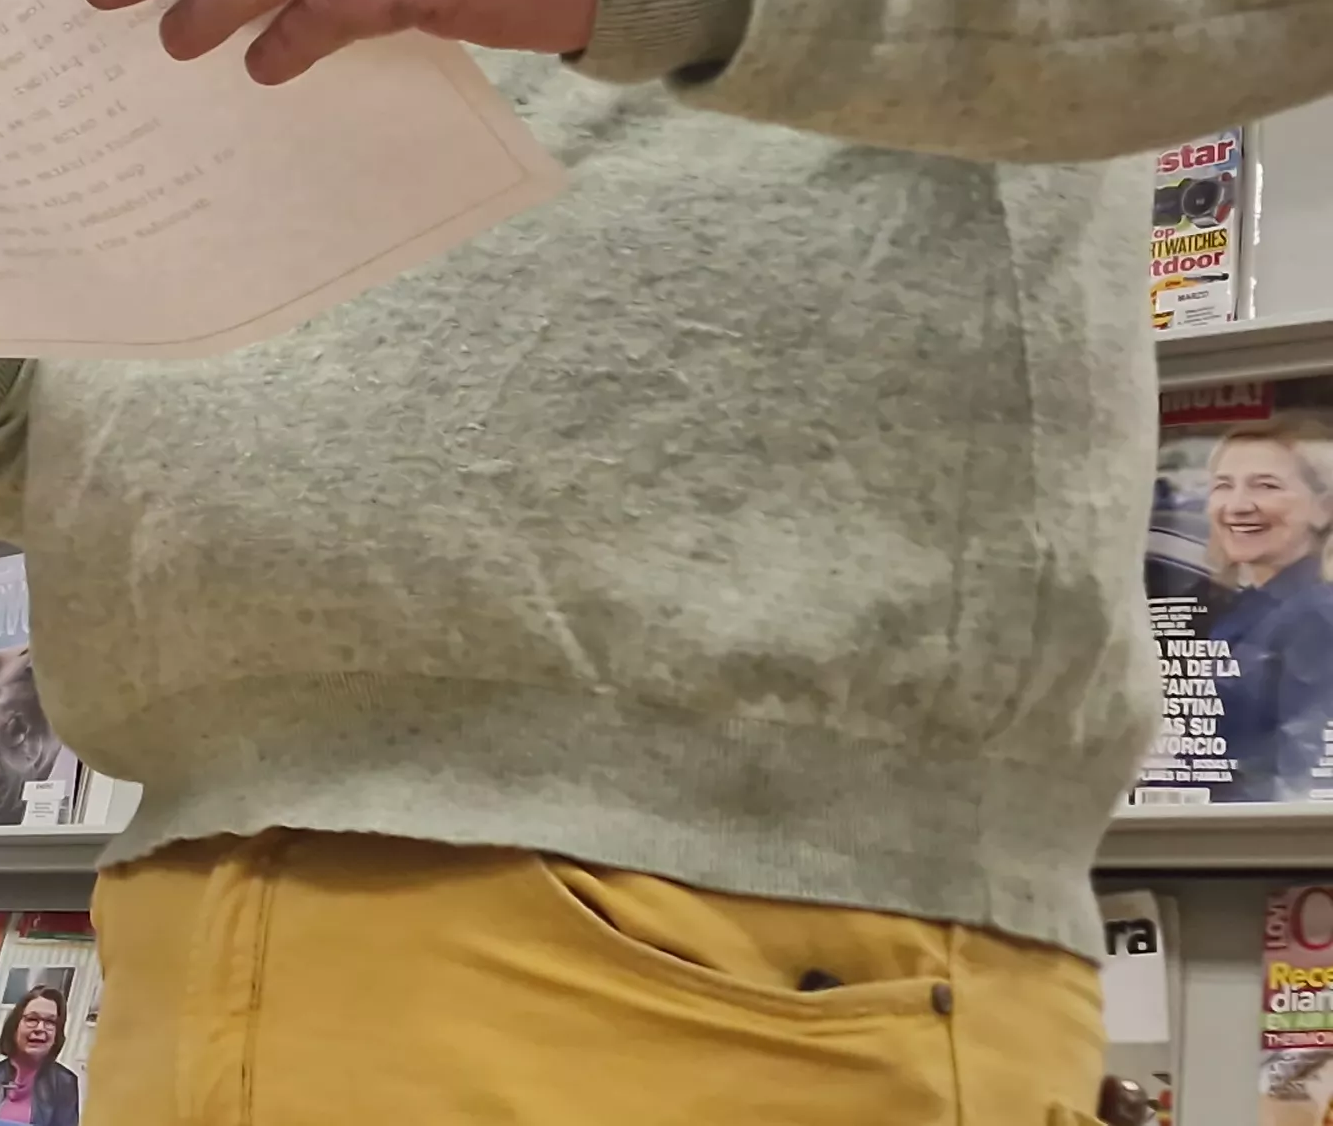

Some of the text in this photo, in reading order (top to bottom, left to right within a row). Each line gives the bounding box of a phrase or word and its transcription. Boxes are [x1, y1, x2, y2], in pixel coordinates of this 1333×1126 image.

[1157, 139, 1234, 173] star
[1149, 250, 1225, 277] tdoor
[1167, 640, 1232, 658] NUEVA
[1187, 659, 1213, 677] DE
[1217, 659, 1241, 677] LA
[1189, 717, 1217, 736] SU
[1151, 736, 1227, 756] VORCIO
